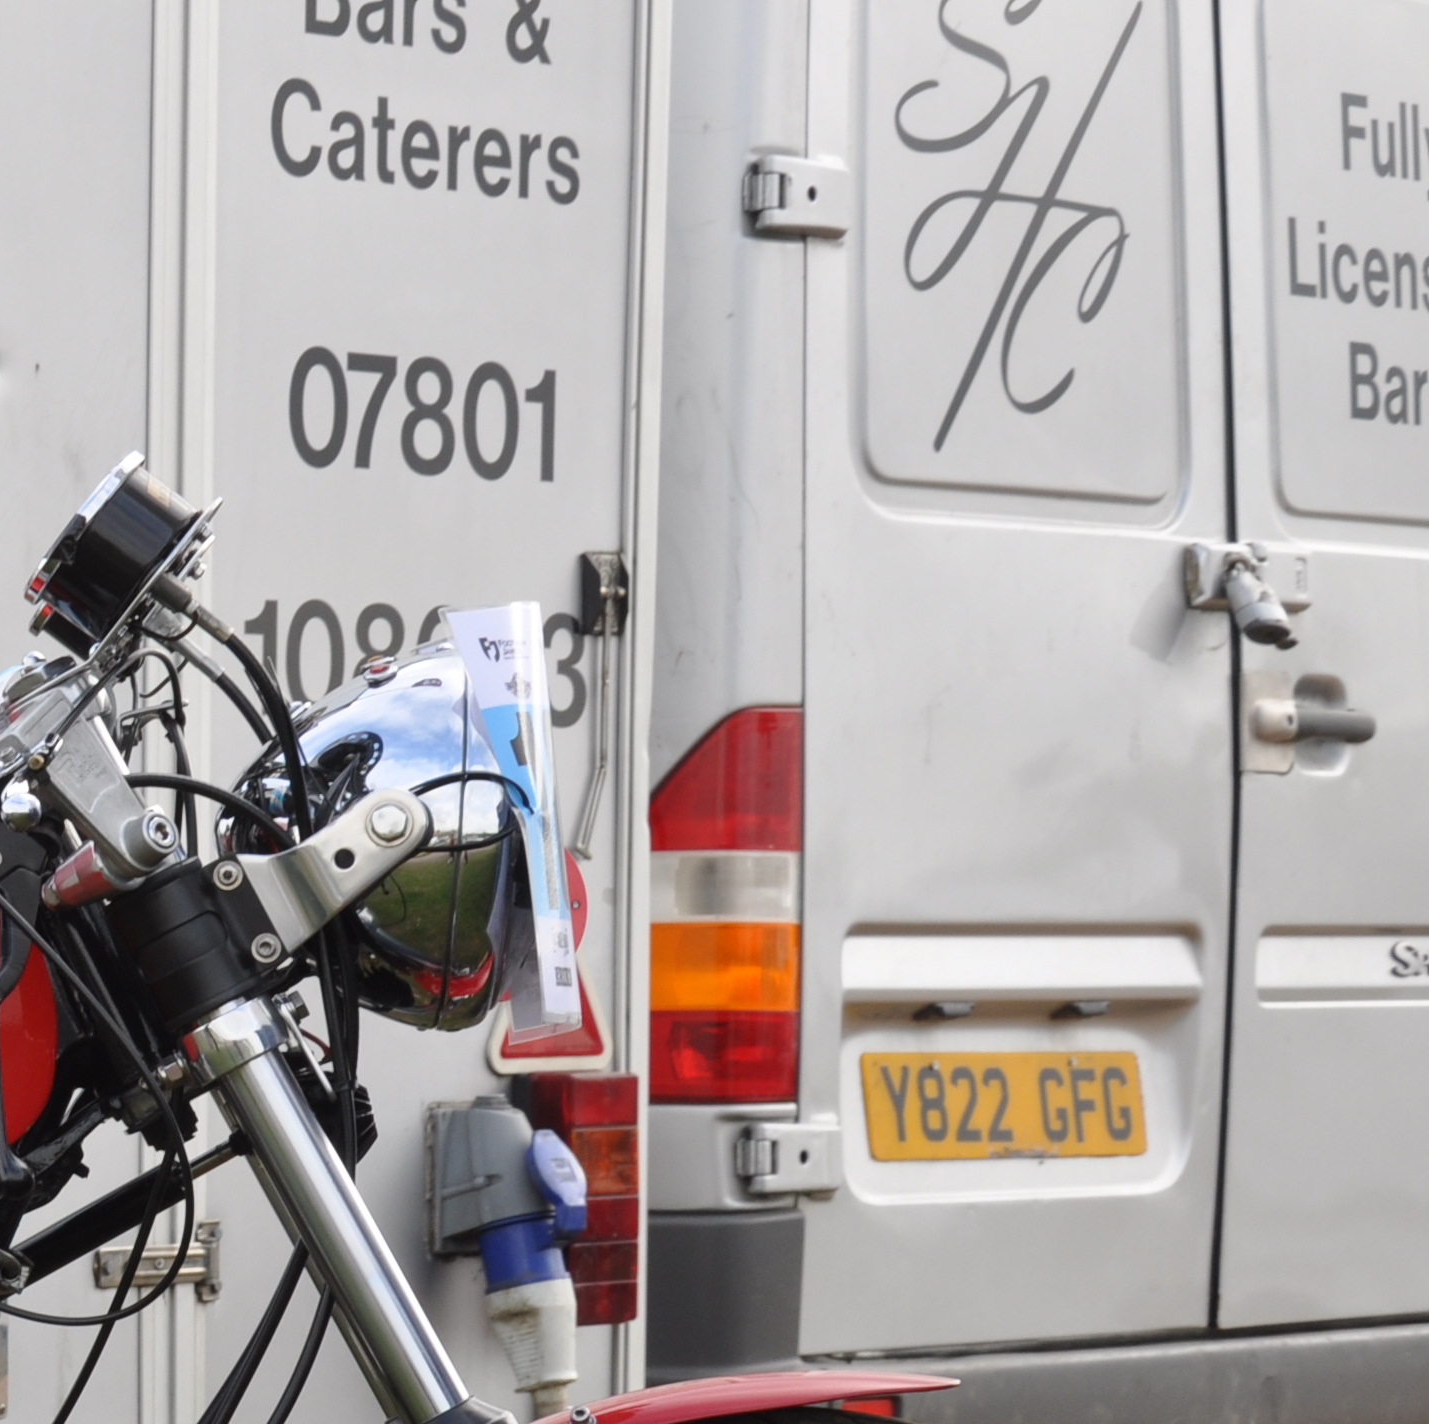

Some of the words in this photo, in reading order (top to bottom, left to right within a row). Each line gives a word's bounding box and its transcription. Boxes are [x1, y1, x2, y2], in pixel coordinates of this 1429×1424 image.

[271, 78, 581, 205] Caterers
[1340, 92, 1429, 203] Full
[288, 345, 557, 482] 07801
[243, 598, 587, 728] 1083
[879, 1066, 1015, 1144] Y822
[1038, 1066, 1134, 1143] GFG
